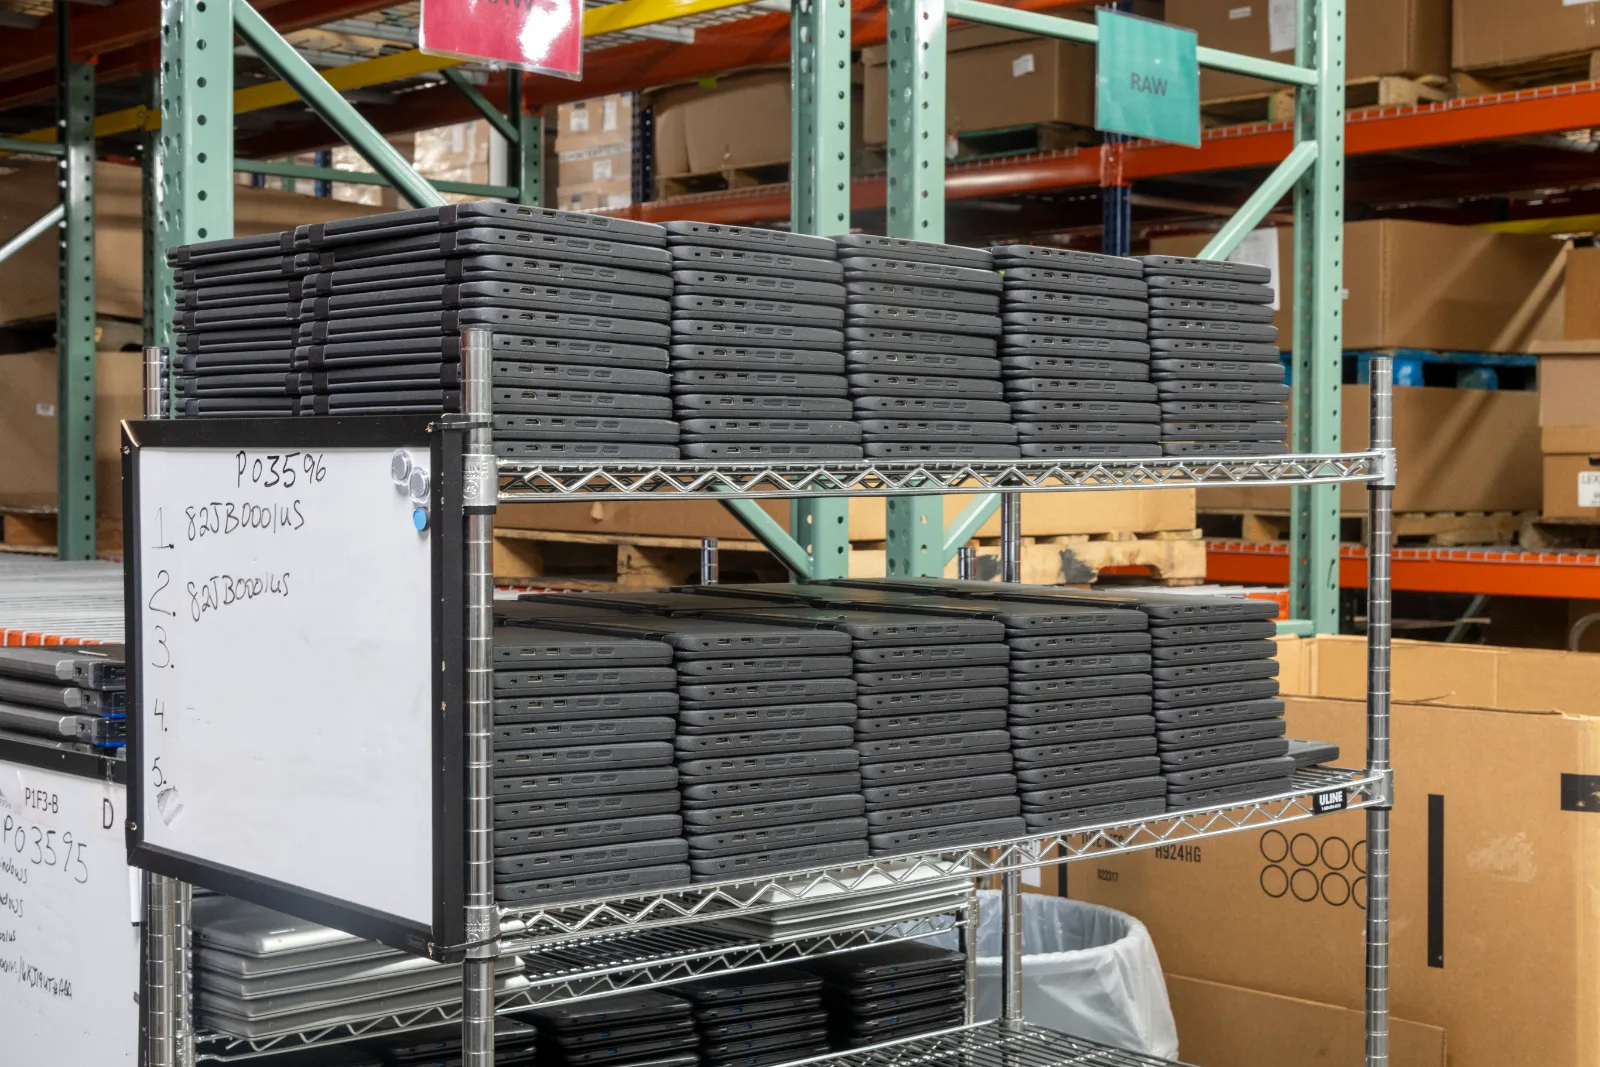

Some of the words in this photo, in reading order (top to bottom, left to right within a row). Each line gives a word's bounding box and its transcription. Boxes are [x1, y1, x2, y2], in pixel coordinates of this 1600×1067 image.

[1131, 71, 1168, 97] RAW
[151, 506, 174, 549] 1.
[149, 569, 176, 617] 2.
[151, 625, 174, 669] 3.
[153, 697, 168, 732] 4.
[151, 756, 167, 788] 5.
[25, 787, 58, 814] P1F3-B
[103, 797, 114, 829] D
[1319, 790, 1343, 806] ULINE
[1155, 843, 1202, 863] H924HG
[0, 857, 27, 884] indows
